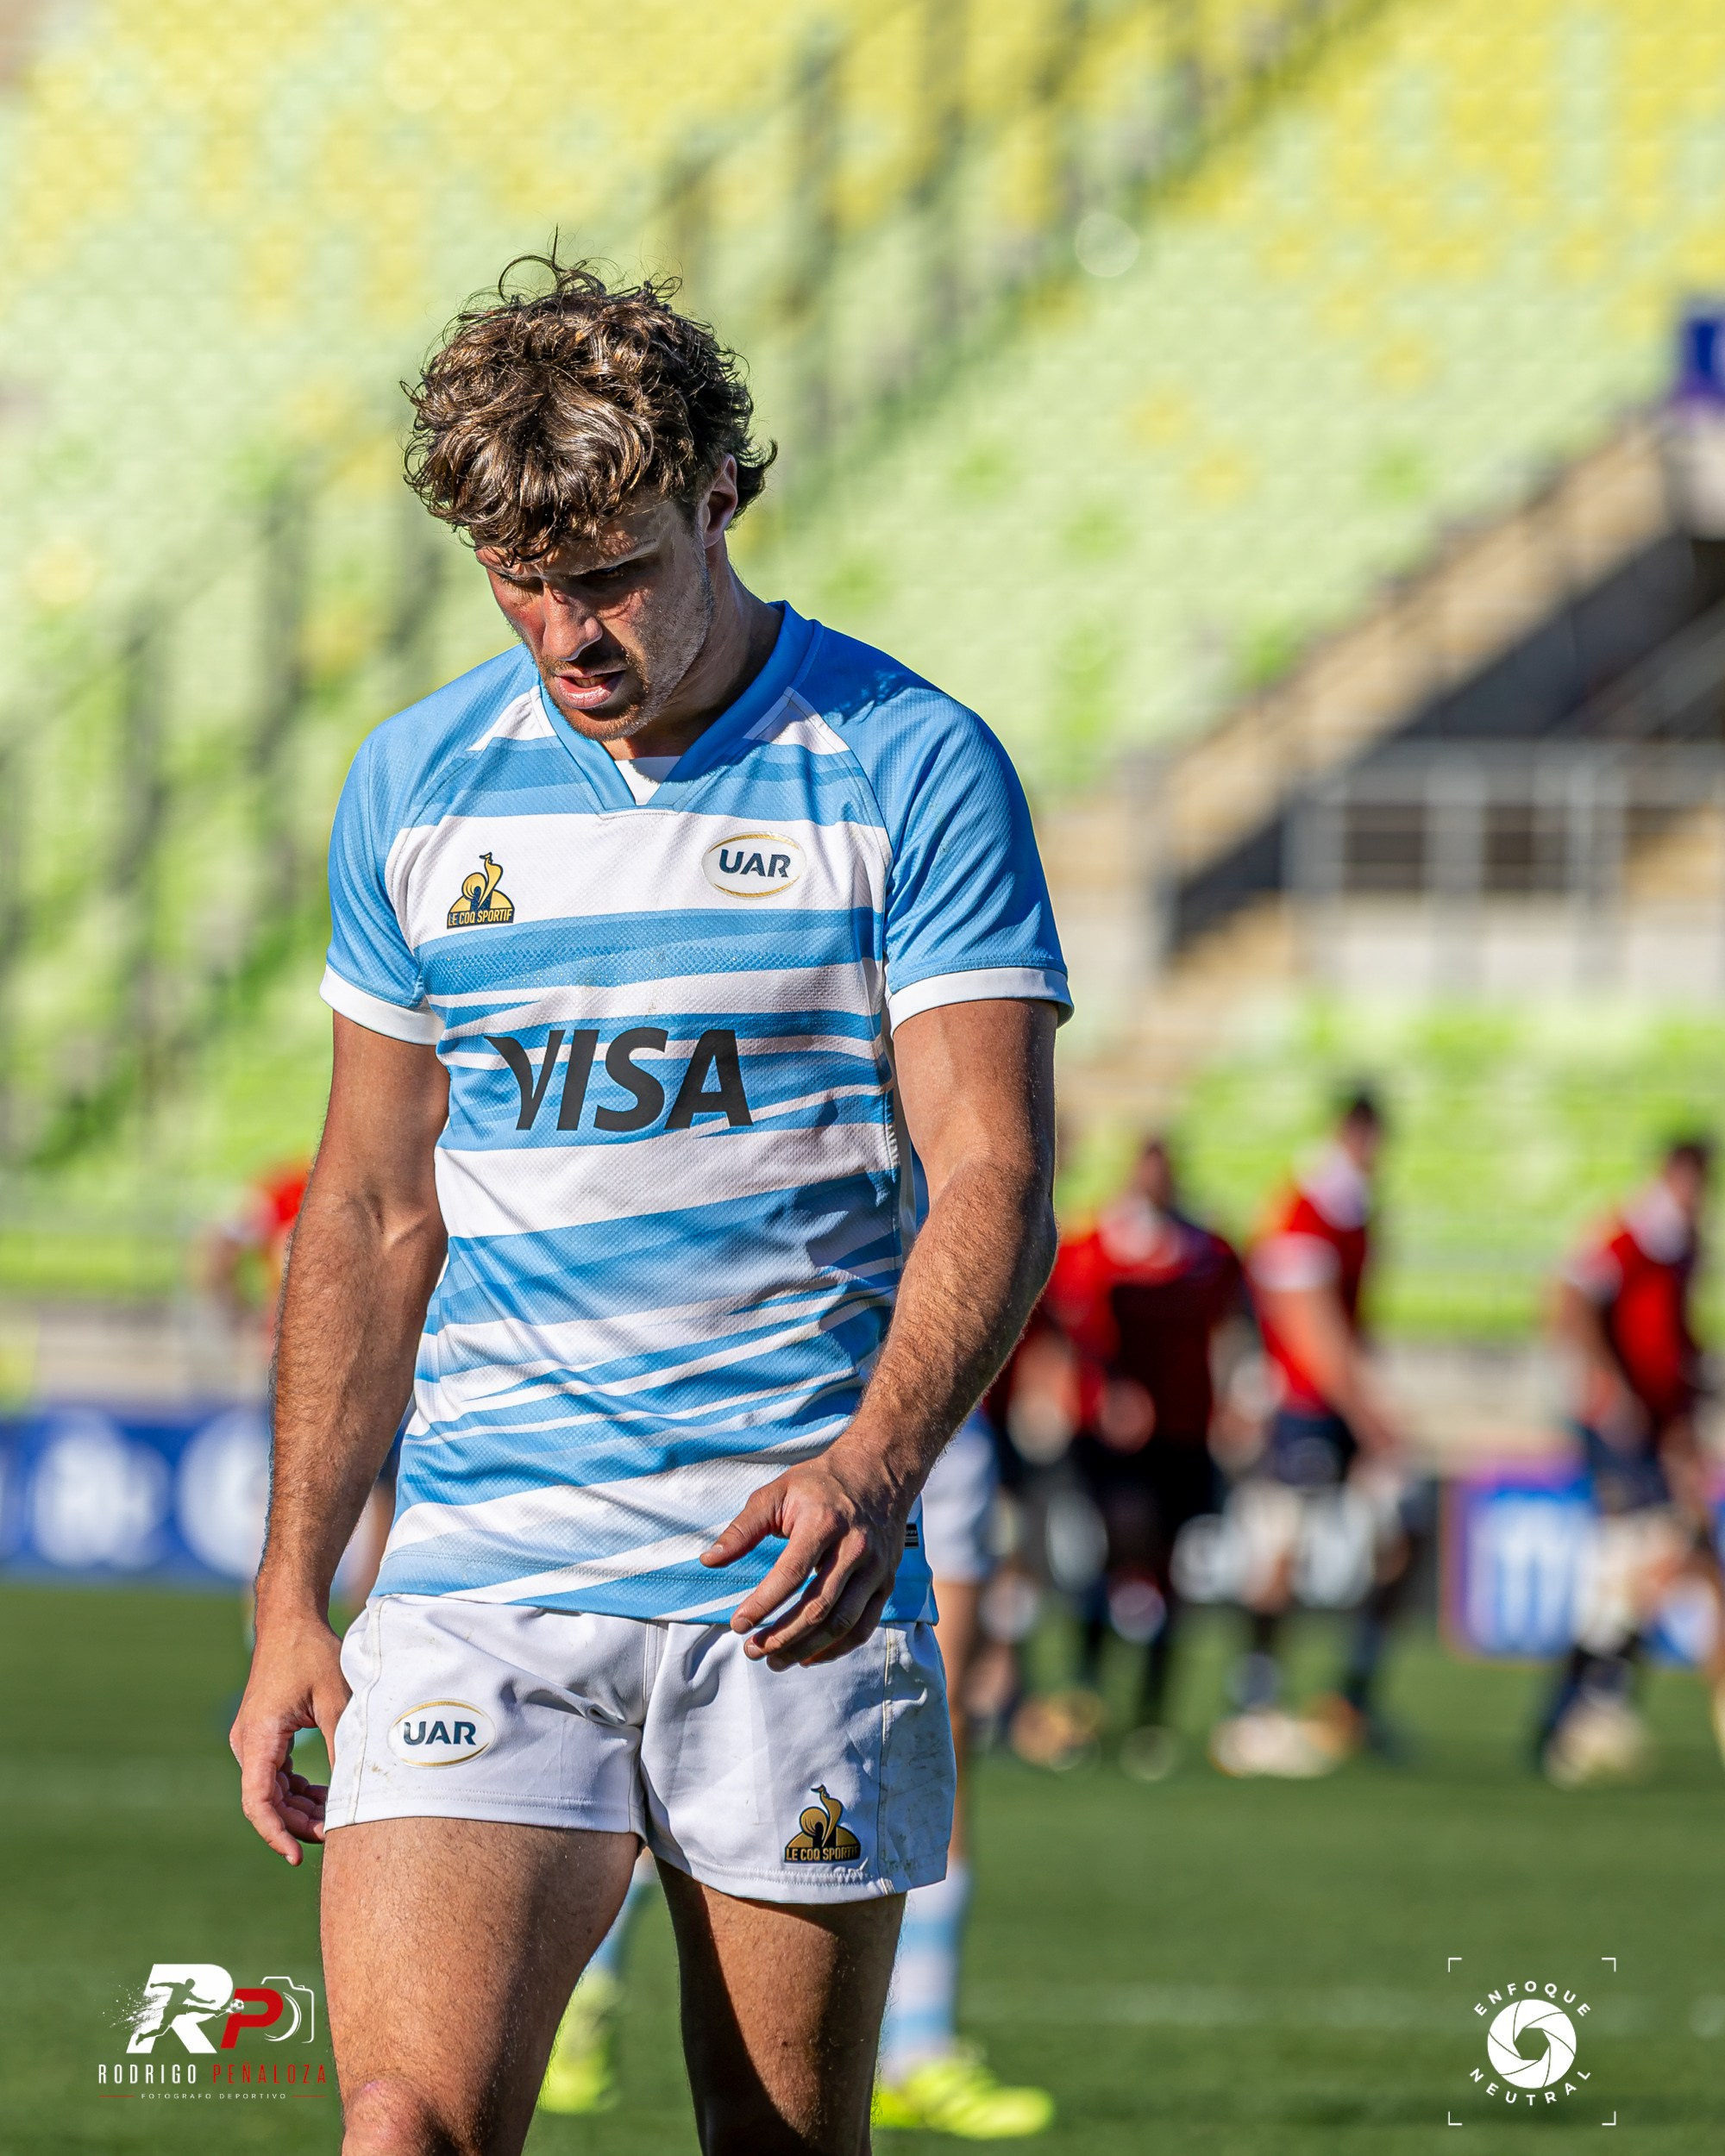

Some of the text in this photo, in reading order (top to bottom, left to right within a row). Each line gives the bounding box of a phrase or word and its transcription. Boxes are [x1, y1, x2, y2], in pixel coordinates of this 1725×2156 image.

[719, 849, 791, 878] UAR
[448, 909, 512, 925] LE COQ SPORTIF
[484, 1026, 754, 1131] VISA
[403, 1720, 477, 1745] UAR
[786, 1847, 799, 1861] LE
[800, 1847, 820, 1861] COQ
